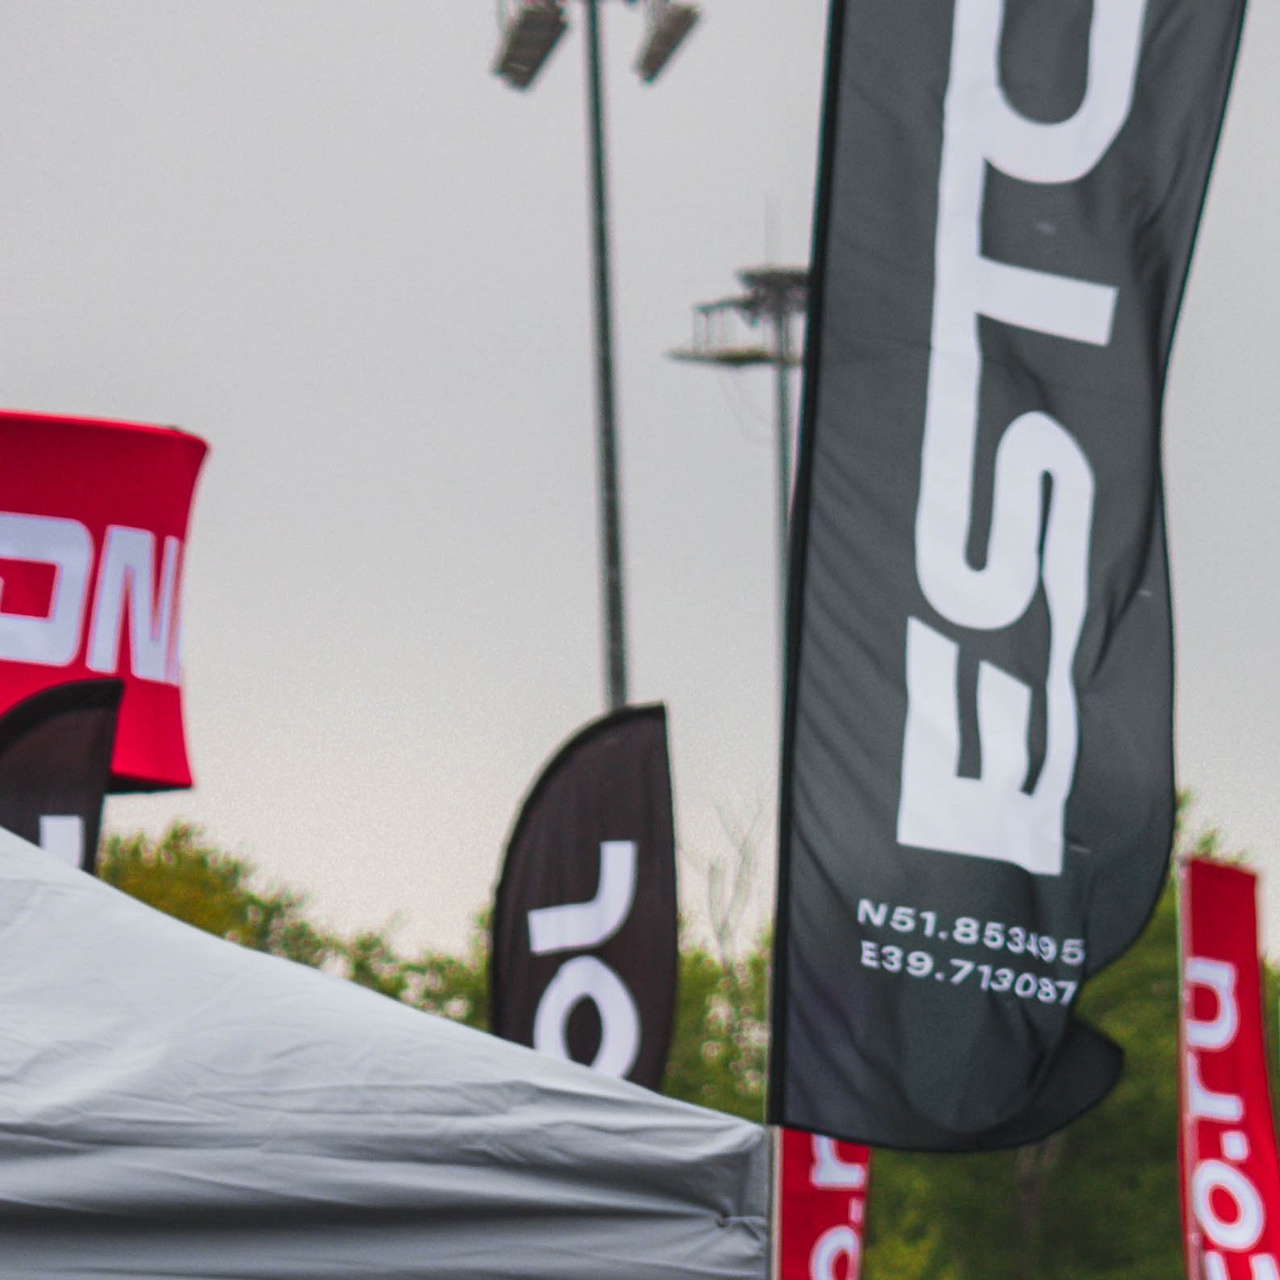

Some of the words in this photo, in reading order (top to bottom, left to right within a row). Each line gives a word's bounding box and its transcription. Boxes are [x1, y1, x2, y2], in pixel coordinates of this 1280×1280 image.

[896, 0, 1145, 876] ESTC
[857, 898, 1086, 967] N51.853495
[860, 940, 1078, 1007] E39.713087
